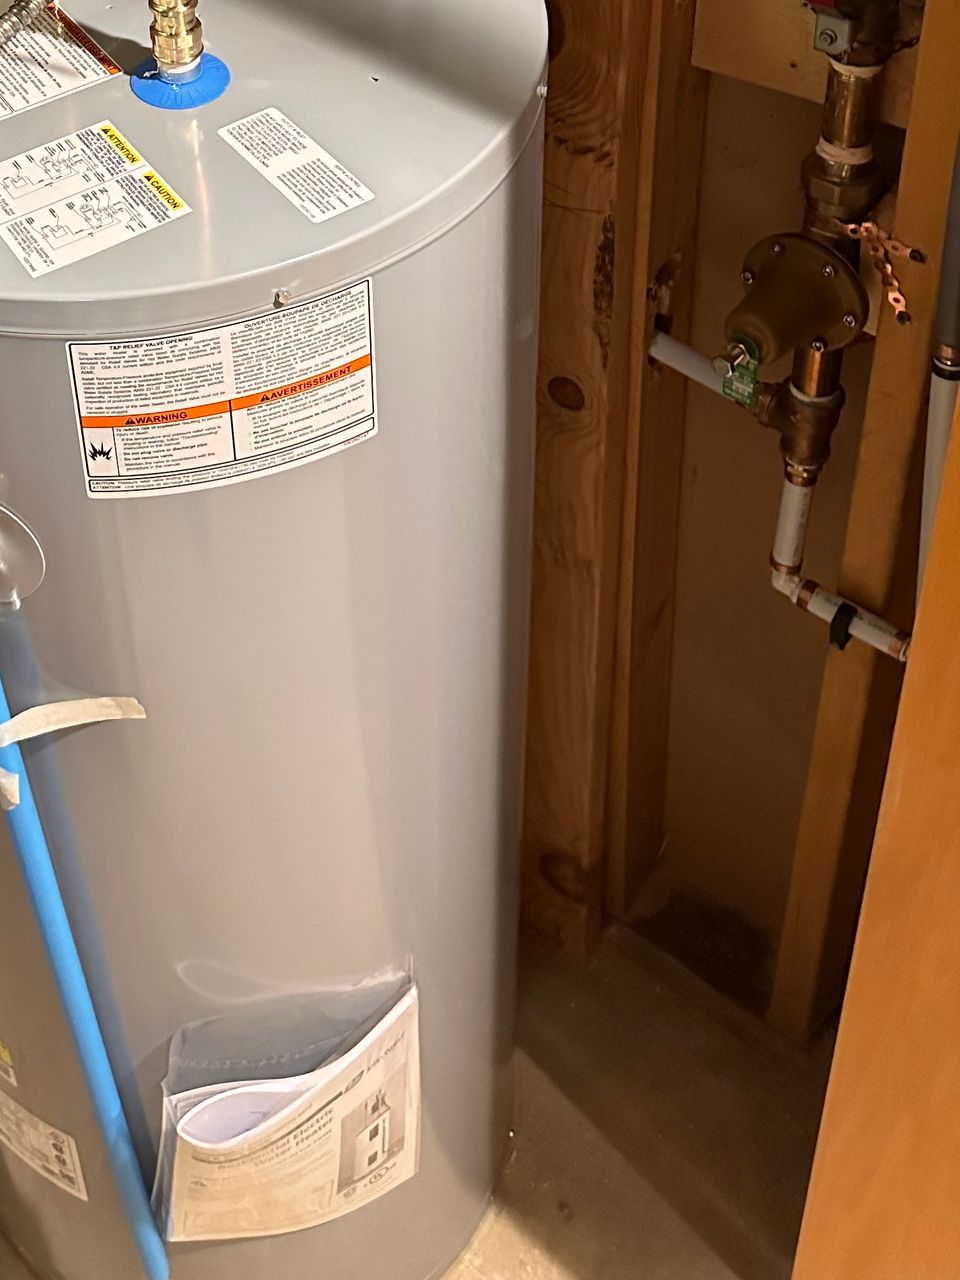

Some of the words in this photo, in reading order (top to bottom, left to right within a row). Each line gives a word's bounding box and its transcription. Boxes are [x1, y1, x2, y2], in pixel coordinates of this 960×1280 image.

[107, 133, 138, 164] ATTENTION
[150, 180, 181, 209] CAUTION
[165, 336, 193, 345] OPENING
[269, 365, 353, 400] AVERTISSEMENT
[135, 412, 188, 425] WARNING
